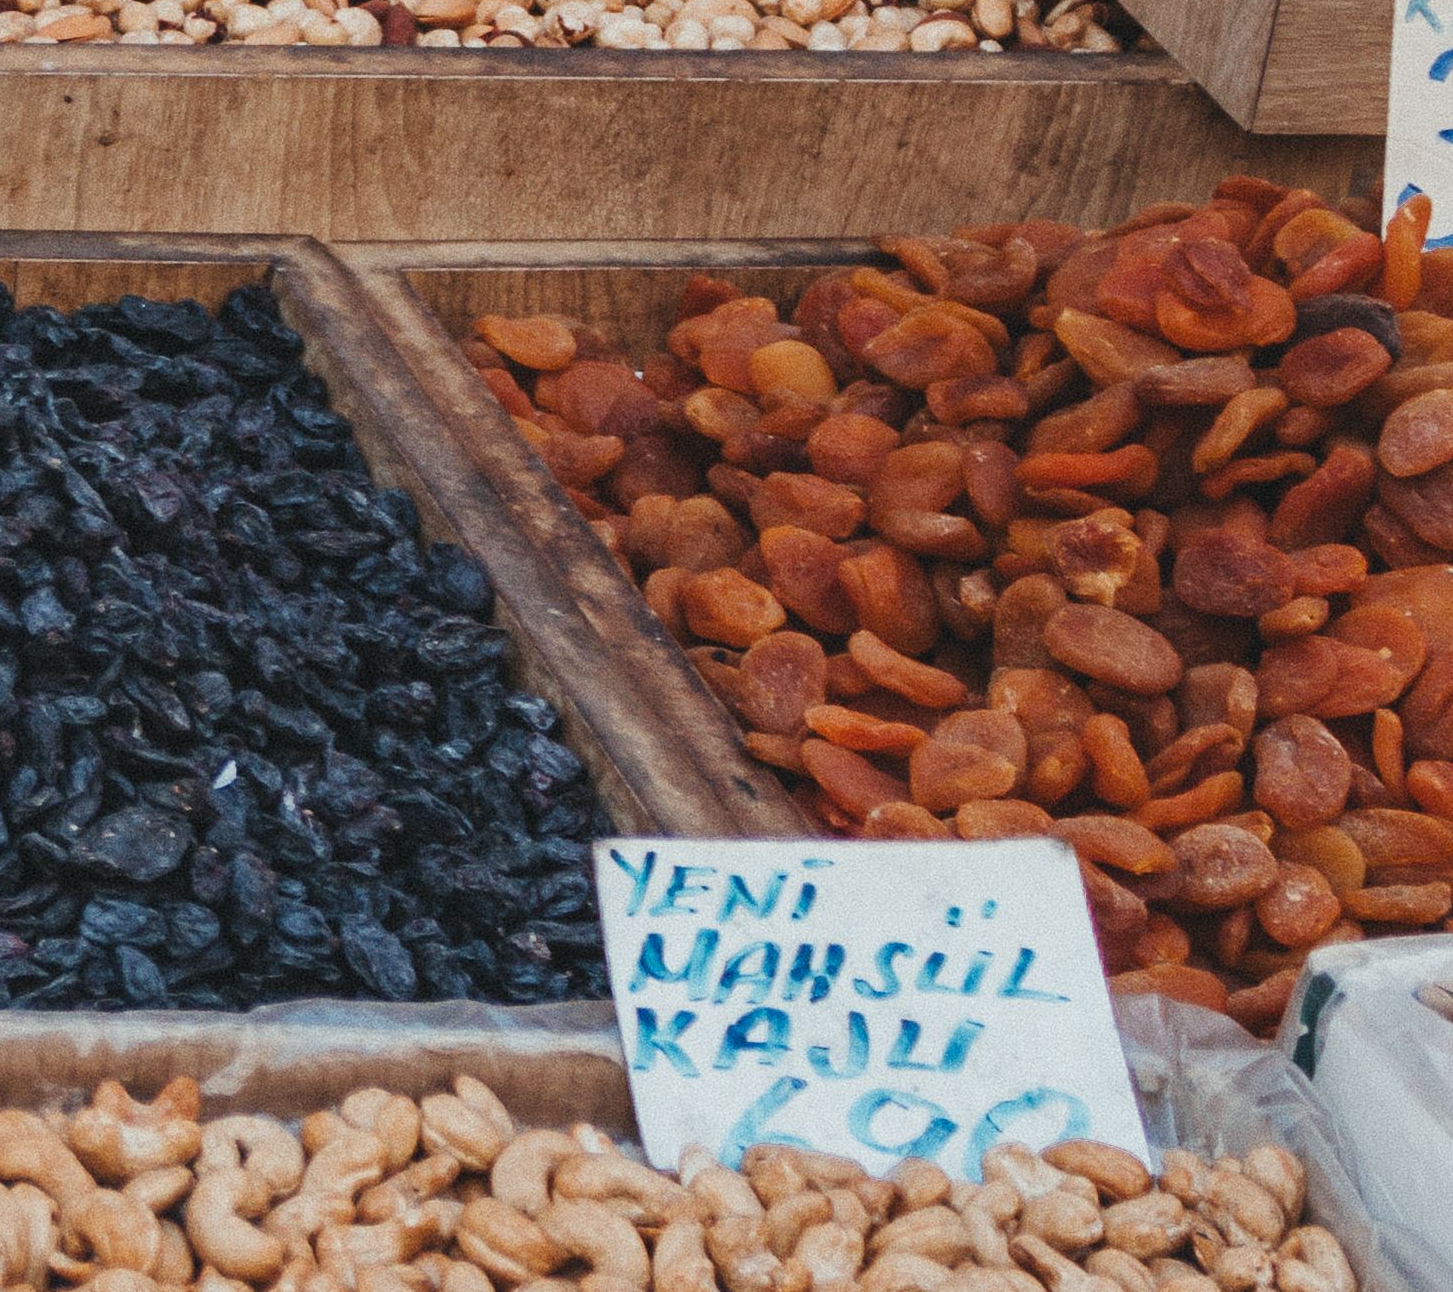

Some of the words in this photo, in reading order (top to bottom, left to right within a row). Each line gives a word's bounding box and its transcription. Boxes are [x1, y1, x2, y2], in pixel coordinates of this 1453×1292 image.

[609, 849, 835, 921] YENİ
[627, 898, 1073, 1005] MAHSÜL
[632, 1006, 986, 1080] KAJU
